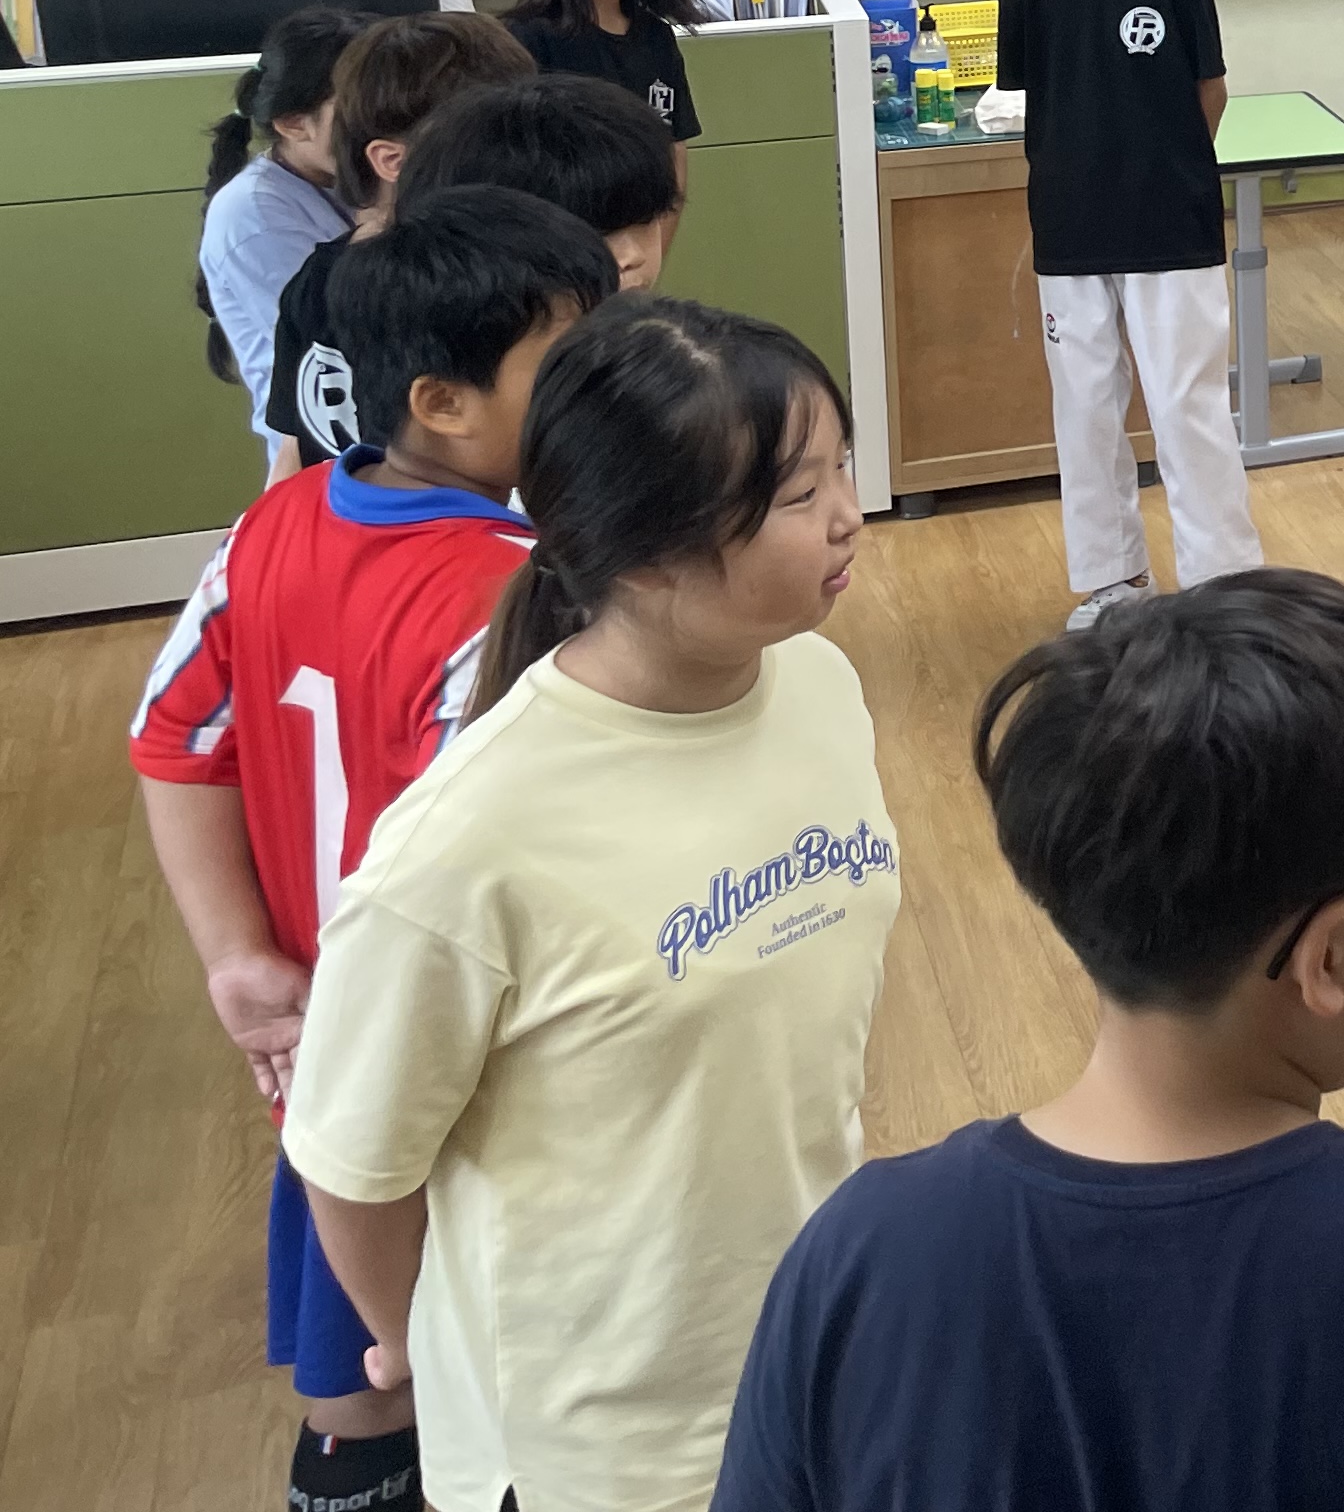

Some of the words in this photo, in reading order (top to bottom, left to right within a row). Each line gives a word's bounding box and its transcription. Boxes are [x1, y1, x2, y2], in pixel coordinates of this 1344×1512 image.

[659, 853, 798, 978] Polham
[794, 820, 897, 883] Boston
[771, 903, 827, 937] Authentic
[757, 922, 808, 959] Founded
[808, 920, 821, 937] in
[821, 907, 846, 929] 1630
